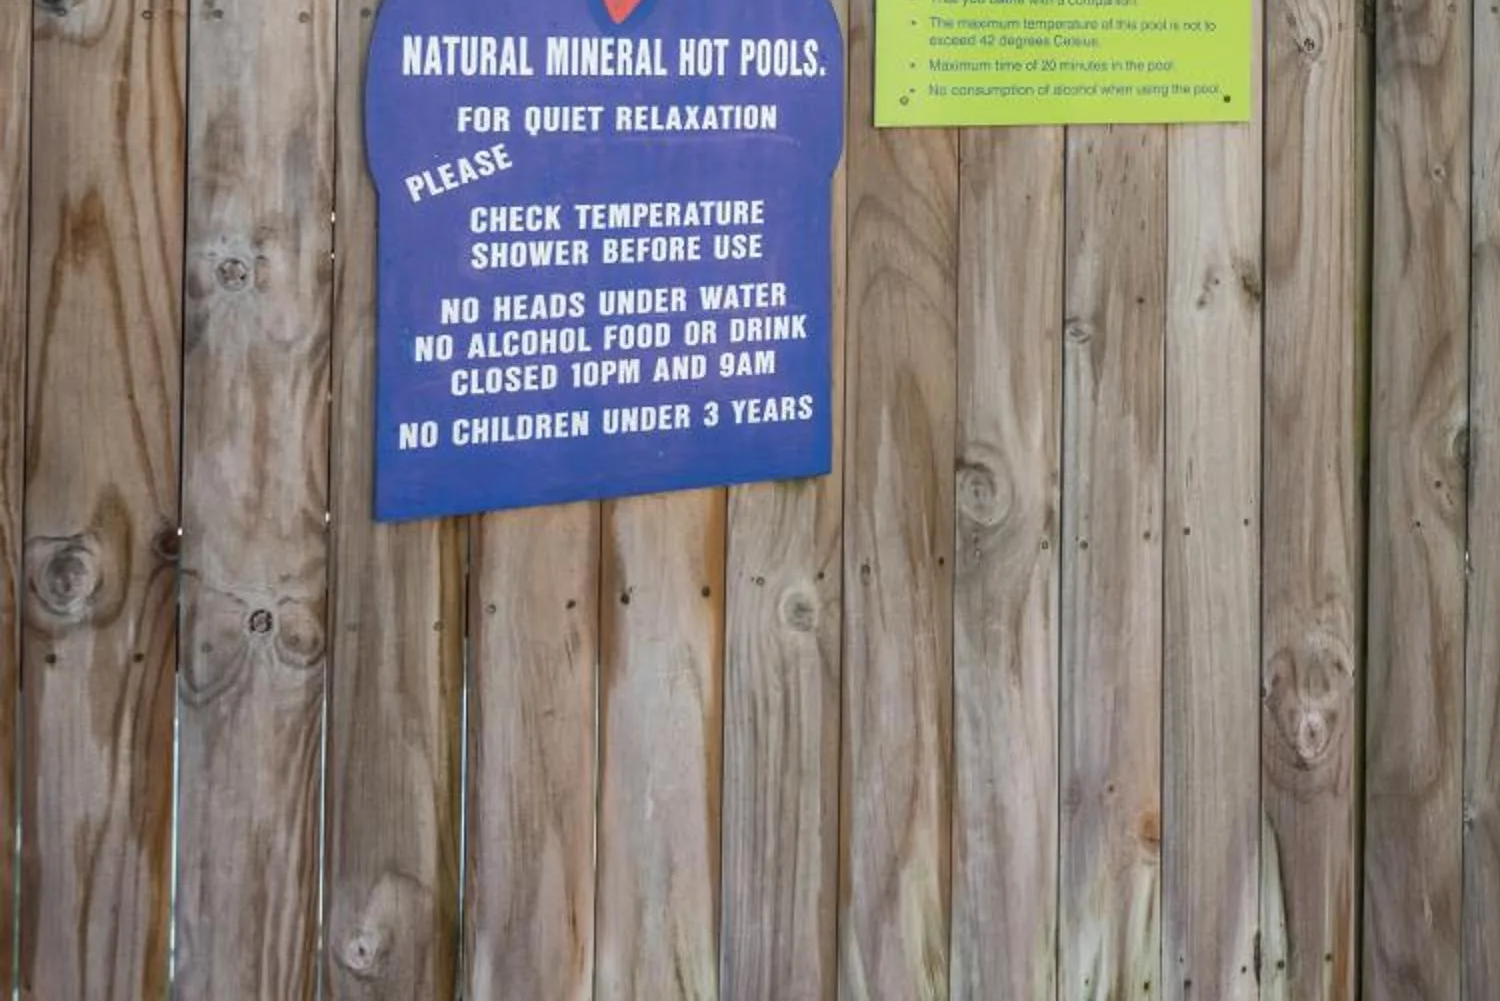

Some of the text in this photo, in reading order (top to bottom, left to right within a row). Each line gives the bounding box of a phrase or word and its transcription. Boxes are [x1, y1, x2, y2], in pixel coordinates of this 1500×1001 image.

[930, 17, 954, 28] The
[1102, 19, 1112, 29] of
[1170, 21, 1179, 29] is
[1184, 23, 1201, 31] not
[1204, 20, 1216, 31] to
[980, 36, 996, 45] 42
[402, 35, 826, 76] NATURAL MINERAL HOT POOLS.
[929, 59, 990, 71] Maximum
[996, 60, 1022, 71] time
[1026, 60, 1038, 70] of
[1042, 60, 1056, 71] 20
[1060, 61, 1108, 71] minutes
[1112, 61, 1122, 70] in
[1126, 61, 1144, 70] the
[457, 104, 777, 136] FOR QUIET RELAXATION
[405, 144, 513, 202] PLEASE
[470, 201, 764, 233] CHECK TEMPERATURE
[471, 235, 762, 269] SHOWER BEFORE USE
[440, 282, 787, 324] NO HEADS UNDER WATER
[415, 315, 806, 362] NO ALCOHOL FOOD OR DRINK
[451, 351, 775, 397] CLOSED 10PM AND 9AM
[399, 395, 813, 450] NO CHILDREN UNDER 3 YEARS
